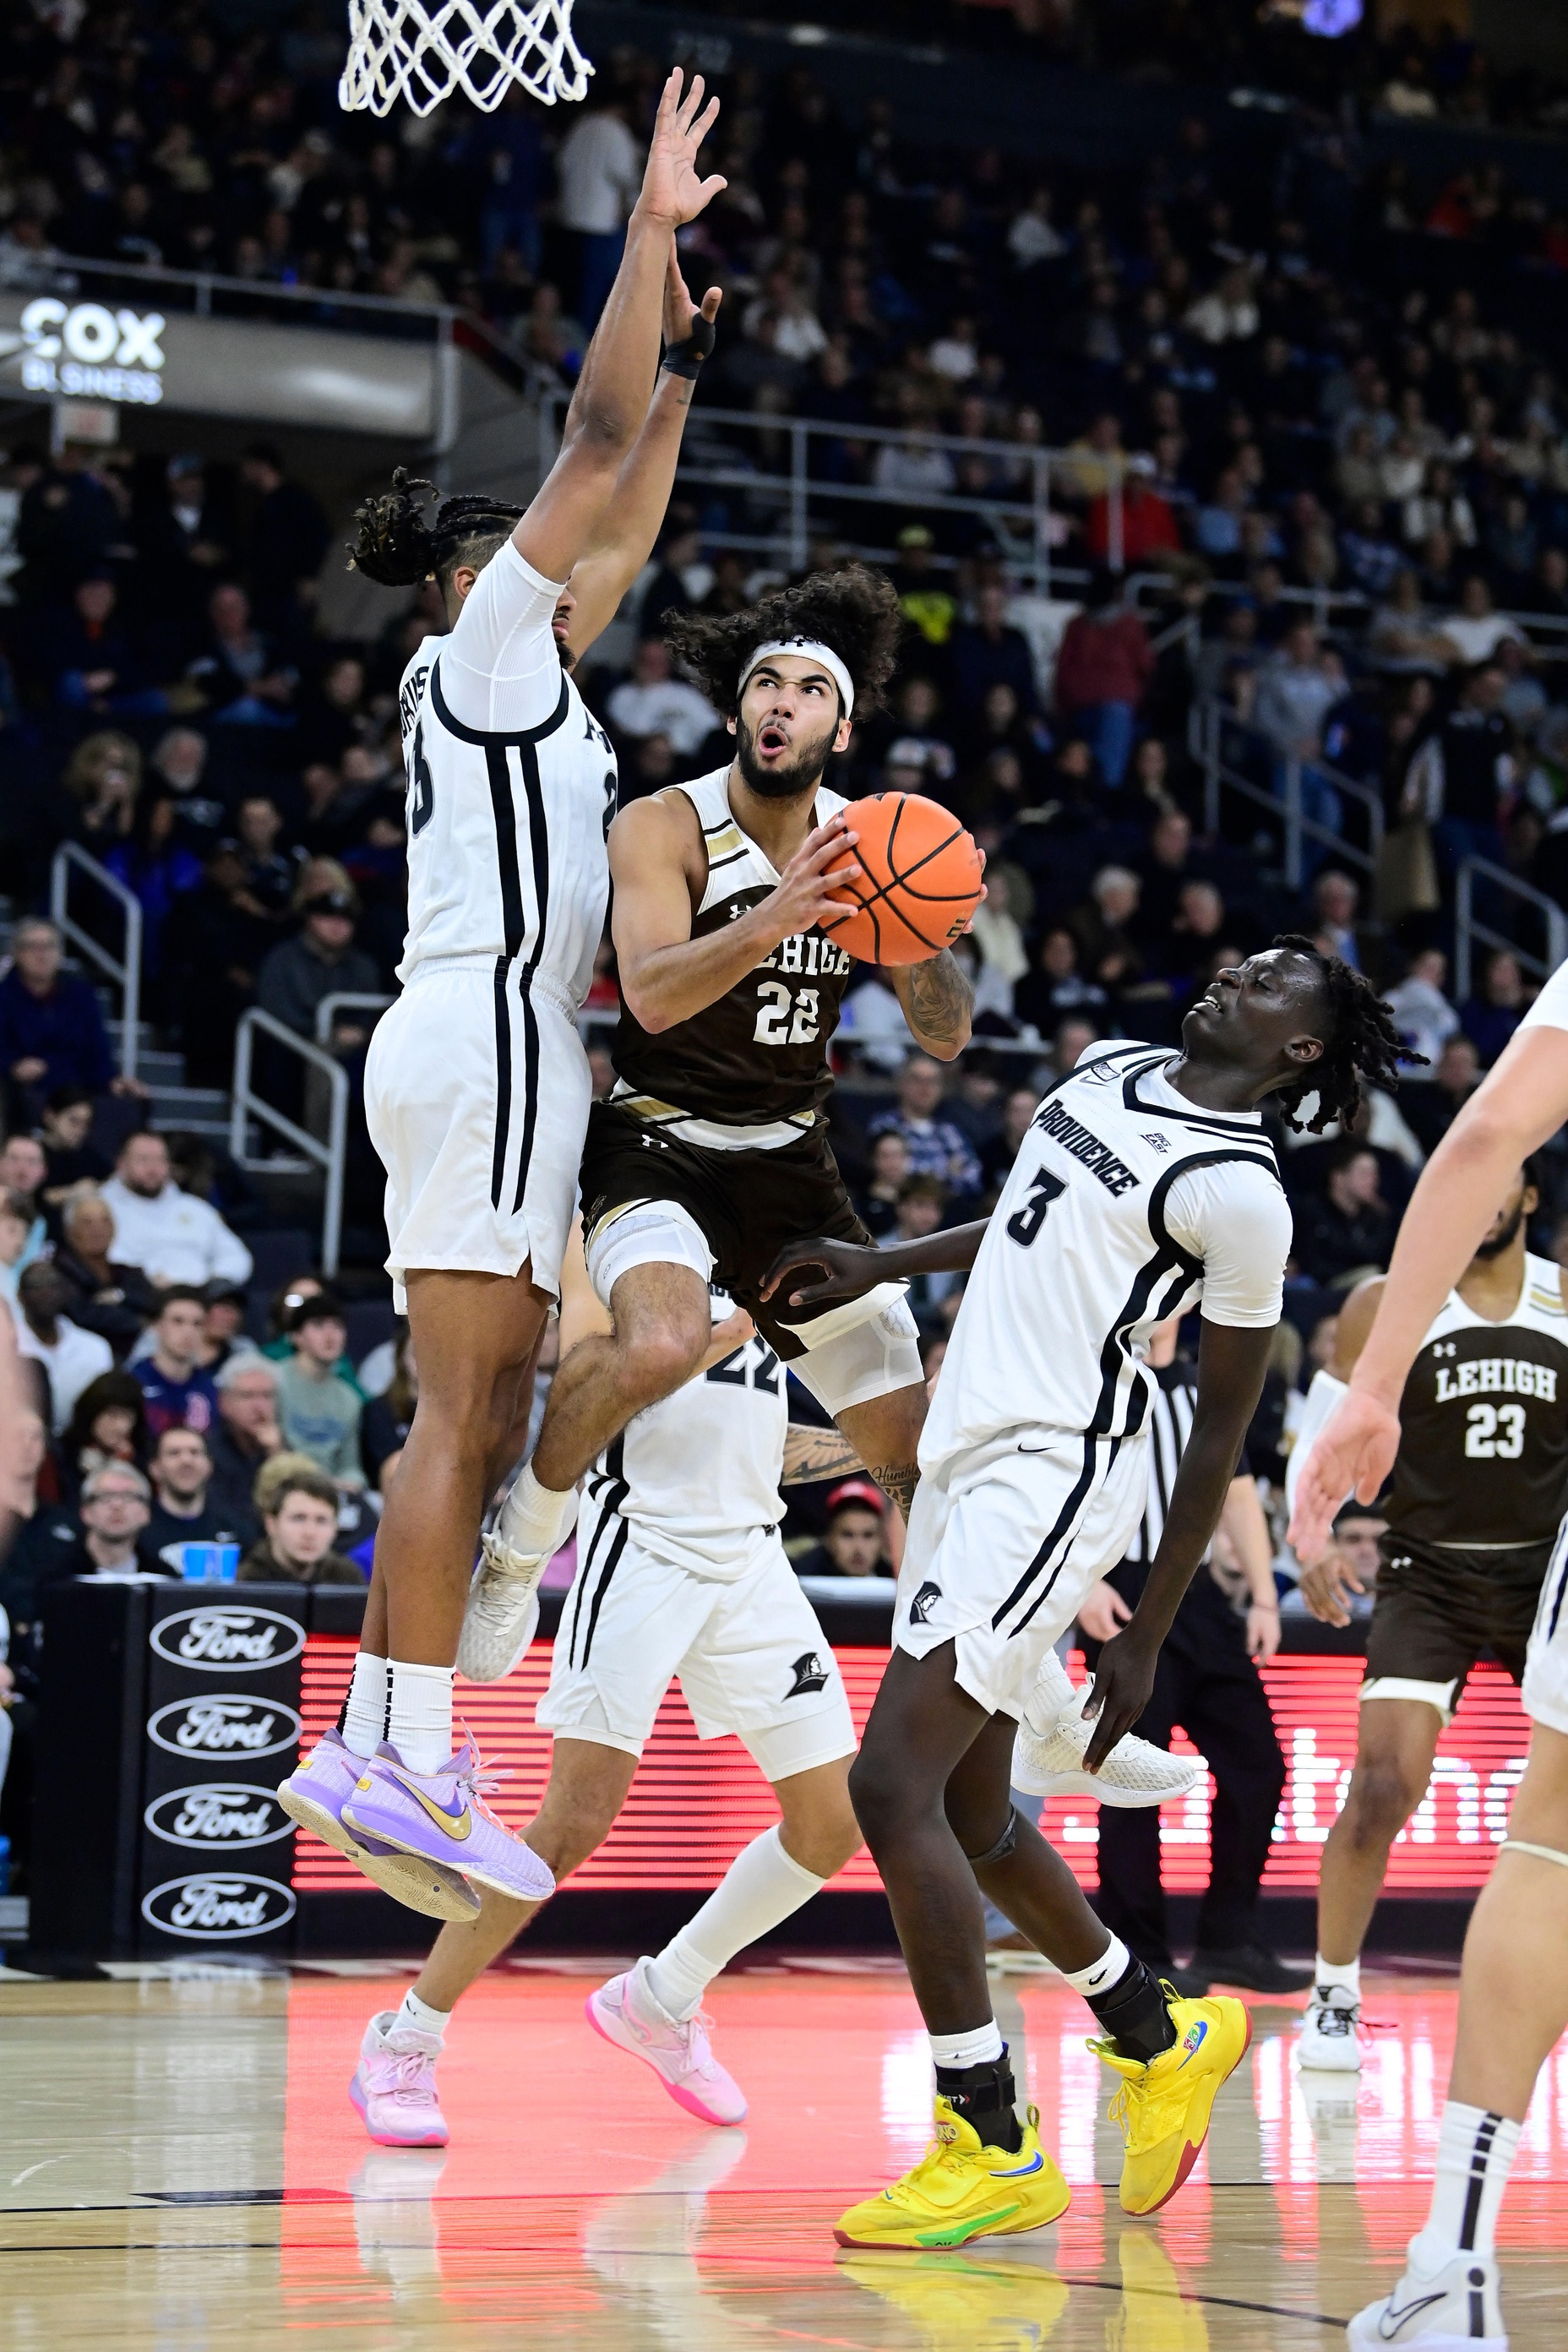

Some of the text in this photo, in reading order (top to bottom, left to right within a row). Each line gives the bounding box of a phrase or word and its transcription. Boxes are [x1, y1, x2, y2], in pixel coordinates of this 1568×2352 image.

[20, 297, 166, 370] COX
[753, 981, 819, 1045] 22
[1029, 1098, 1142, 1199] PROVIDENCE
[1145, 1134, 1168, 1154] EAST
[1153, 1133, 1172, 1146] BIG
[1005, 1163, 1070, 1250] 3
[1435, 1358, 1558, 1403] LEHIGH
[1465, 1403, 1527, 1459] 23
[179, 1615, 278, 1659] Ford
[177, 1703, 275, 1749] Ford
[173, 1793, 274, 1837] Ford
[171, 1881, 270, 1927] Ford
